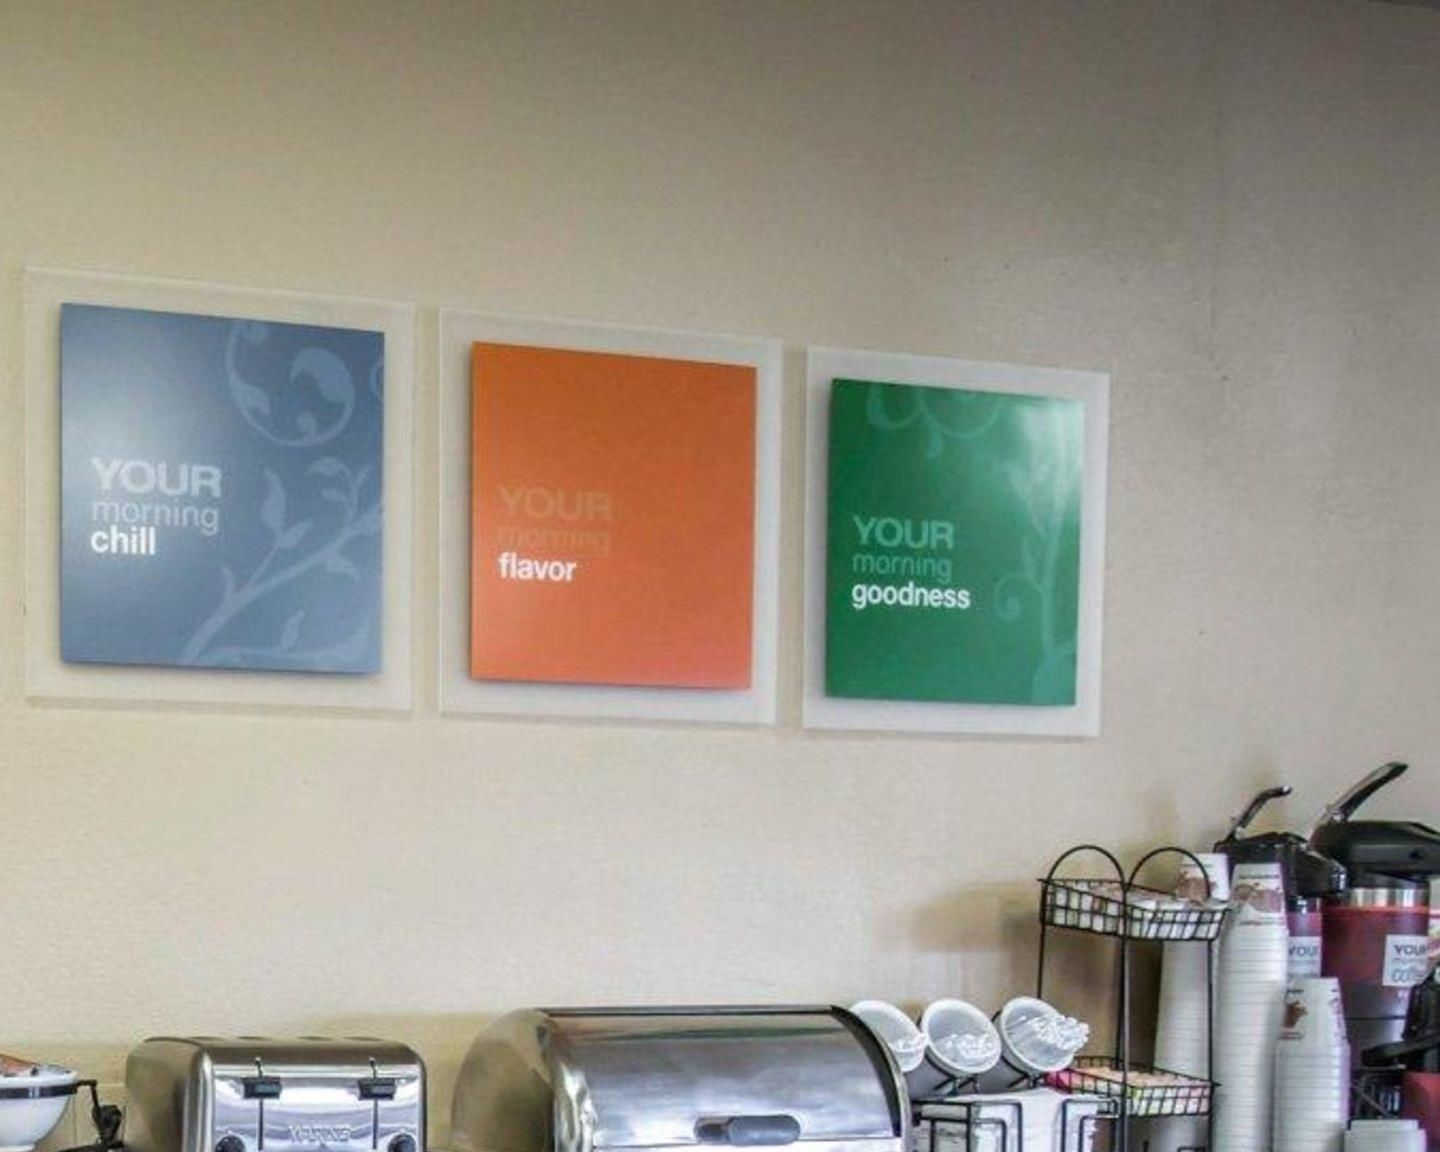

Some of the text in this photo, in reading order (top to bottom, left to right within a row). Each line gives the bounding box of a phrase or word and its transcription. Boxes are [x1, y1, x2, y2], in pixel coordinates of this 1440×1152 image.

[91, 457, 222, 498] YOUR
[92, 499, 219, 536] morning
[498, 485, 612, 522] YOUR
[91, 525, 156, 555] chill
[852, 515, 955, 550] YOUR
[498, 551, 578, 581] flavor
[852, 553, 952, 585] morning
[851, 580, 971, 610] goodness
